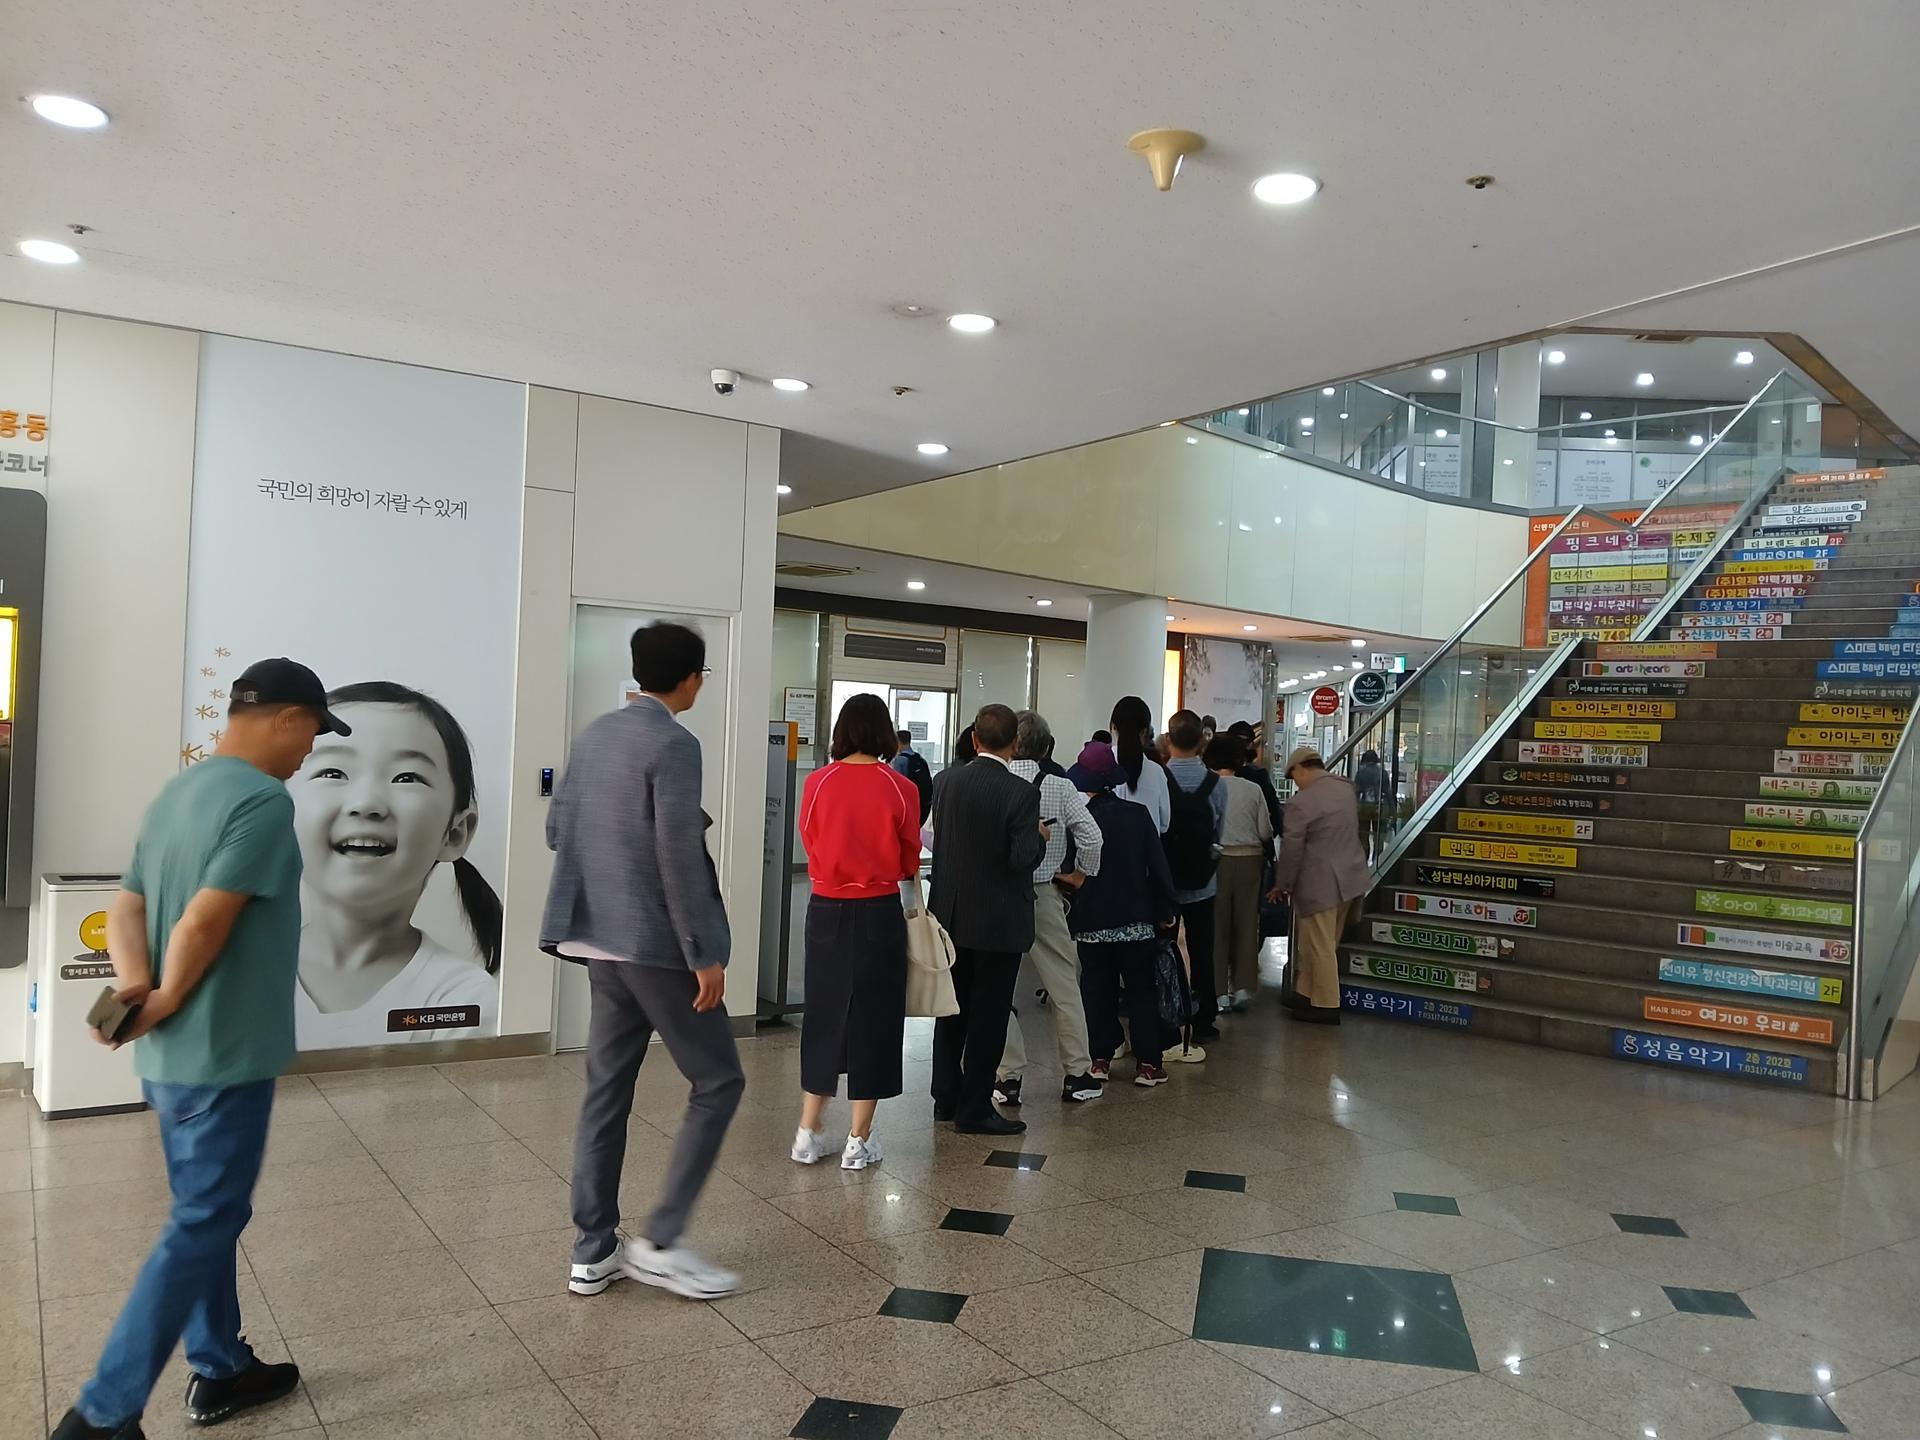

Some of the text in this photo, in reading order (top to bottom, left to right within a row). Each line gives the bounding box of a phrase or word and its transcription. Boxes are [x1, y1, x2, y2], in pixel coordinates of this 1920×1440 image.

[0, 449, 48, 477] 코너
[257, 478, 468, 520] 국민의 희망이 자랄 수 있게
[1566, 533, 1639, 551] 핑크네일
[1815, 550, 1829, 558] 2F
[1815, 561, 1827, 569] 2F
[1594, 614, 1645, 626] 745-628
[1702, 613, 1762, 626] 신동아약국
[1691, 627, 1751, 640] 신동아약국
[1575, 702, 1663, 716] 아이누리 한의원
[1831, 706, 1912, 721] 아이누리 한
[1819, 731, 1875, 744] 아이누리
[1764, 779, 1820, 798] 예수마을
[1750, 807, 1806, 825] 예수마을
[1576, 824, 1591, 835] 2F
[1431, 869, 1518, 891] 성남펜싱아카데미
[1724, 900, 1758, 912] 아이
[1399, 928, 1470, 950] 성민치과
[1775, 940, 1813, 953] 미술교육
[1833, 946, 1846, 957] 2F
[1376, 960, 1448, 984] 성민치과
[1701, 967, 1816, 996] 정신건강의학과의원
[1823, 984, 1840, 996] 2F
[1344, 989, 1412, 1016] 성음악기
[1650, 1005, 1692, 1017] HAIR SHOP
[419, 1012, 466, 1024] KB국민은행
[1699, 1007, 1749, 1026] 여기야
[1643, 1039, 1793, 1069] 성음악기 2층 202호
